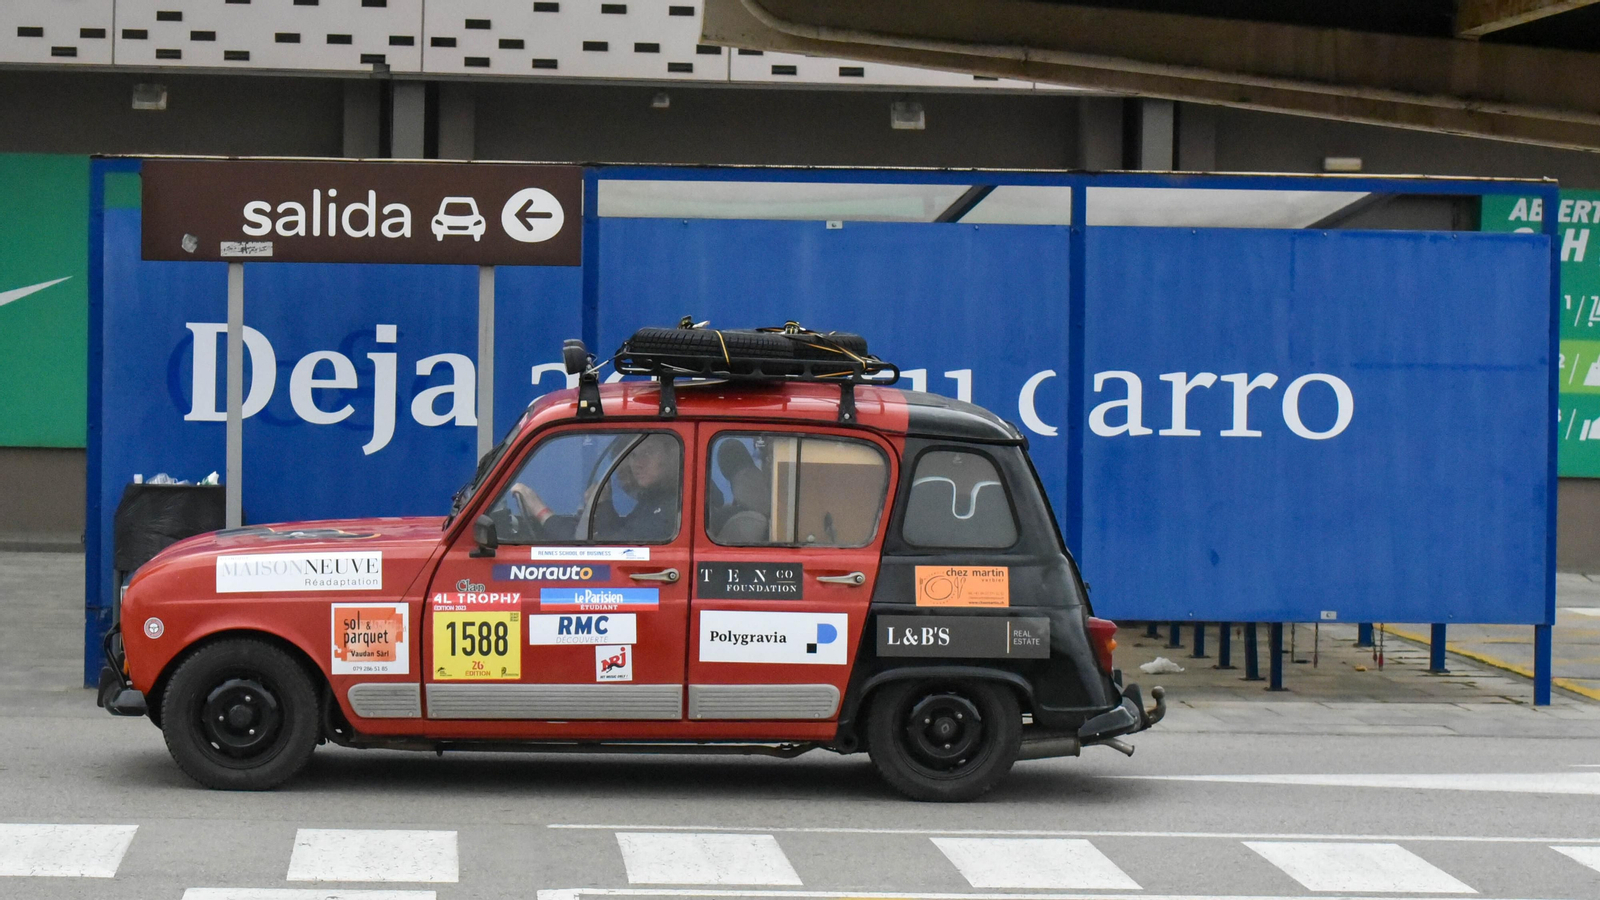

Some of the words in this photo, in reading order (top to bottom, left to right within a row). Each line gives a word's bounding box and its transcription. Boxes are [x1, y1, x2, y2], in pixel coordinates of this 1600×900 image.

[242, 188, 412, 238] salida
[183, 321, 477, 456] Deja
[1018, 369, 1355, 440] carro
[510, 565, 593, 580] Norauto
[946, 567, 968, 577] chez
[972, 568, 1005, 578] martin
[305, 578, 379, 587] Réadaptation
[726, 584, 797, 593] FOUNDATION
[433, 593, 452, 604] 4L
[457, 593, 520, 604] TROPHY
[574, 592, 585, 604] Le
[585, 589, 624, 604] Parisien
[343, 610, 360, 631] sol
[365, 621, 371, 630] &
[558, 615, 609, 635] RMC
[343, 630, 389, 648] parquet
[446, 621, 508, 657] 1588
[556, 635, 609, 644] DÉCOUVERTE
[710, 630, 787, 646] Polygravia
[887, 626, 950, 646] L&B'S
[1013, 630, 1032, 638] REAL
[1013, 638, 1041, 646] ESTATE
